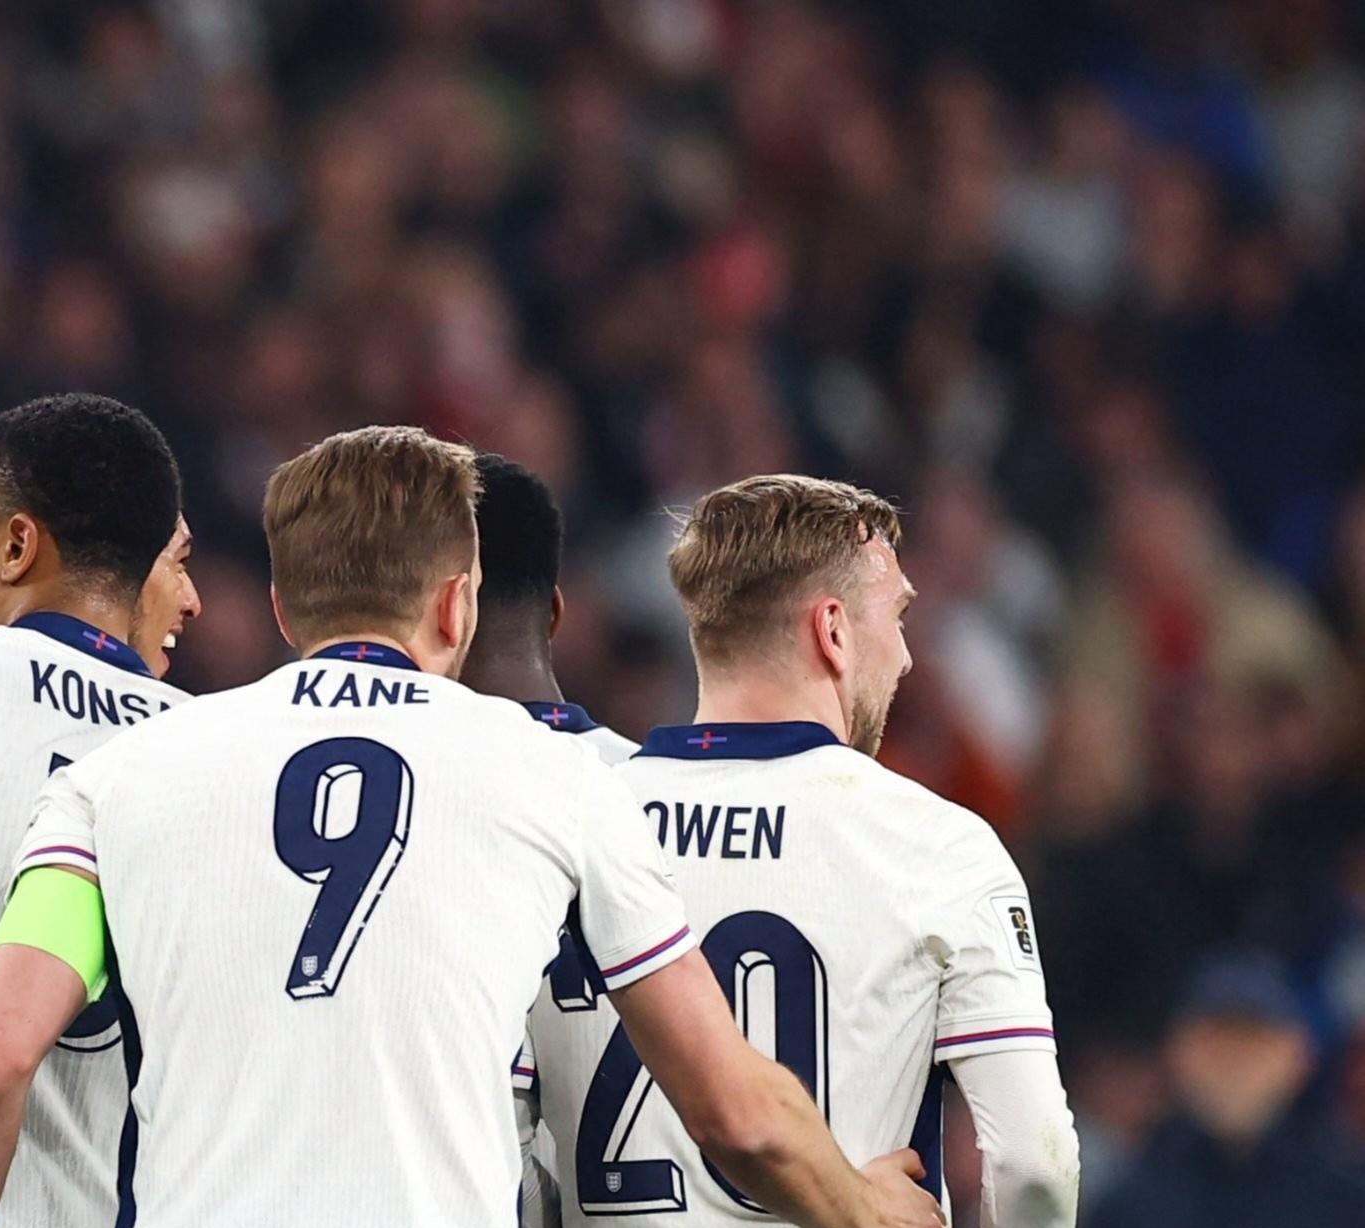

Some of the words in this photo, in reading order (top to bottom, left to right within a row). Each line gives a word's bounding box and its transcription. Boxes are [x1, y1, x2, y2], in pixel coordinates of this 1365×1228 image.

[30, 660, 170, 726] KONS
[291, 669, 429, 708] KANE
[273, 736, 416, 1000] 9
